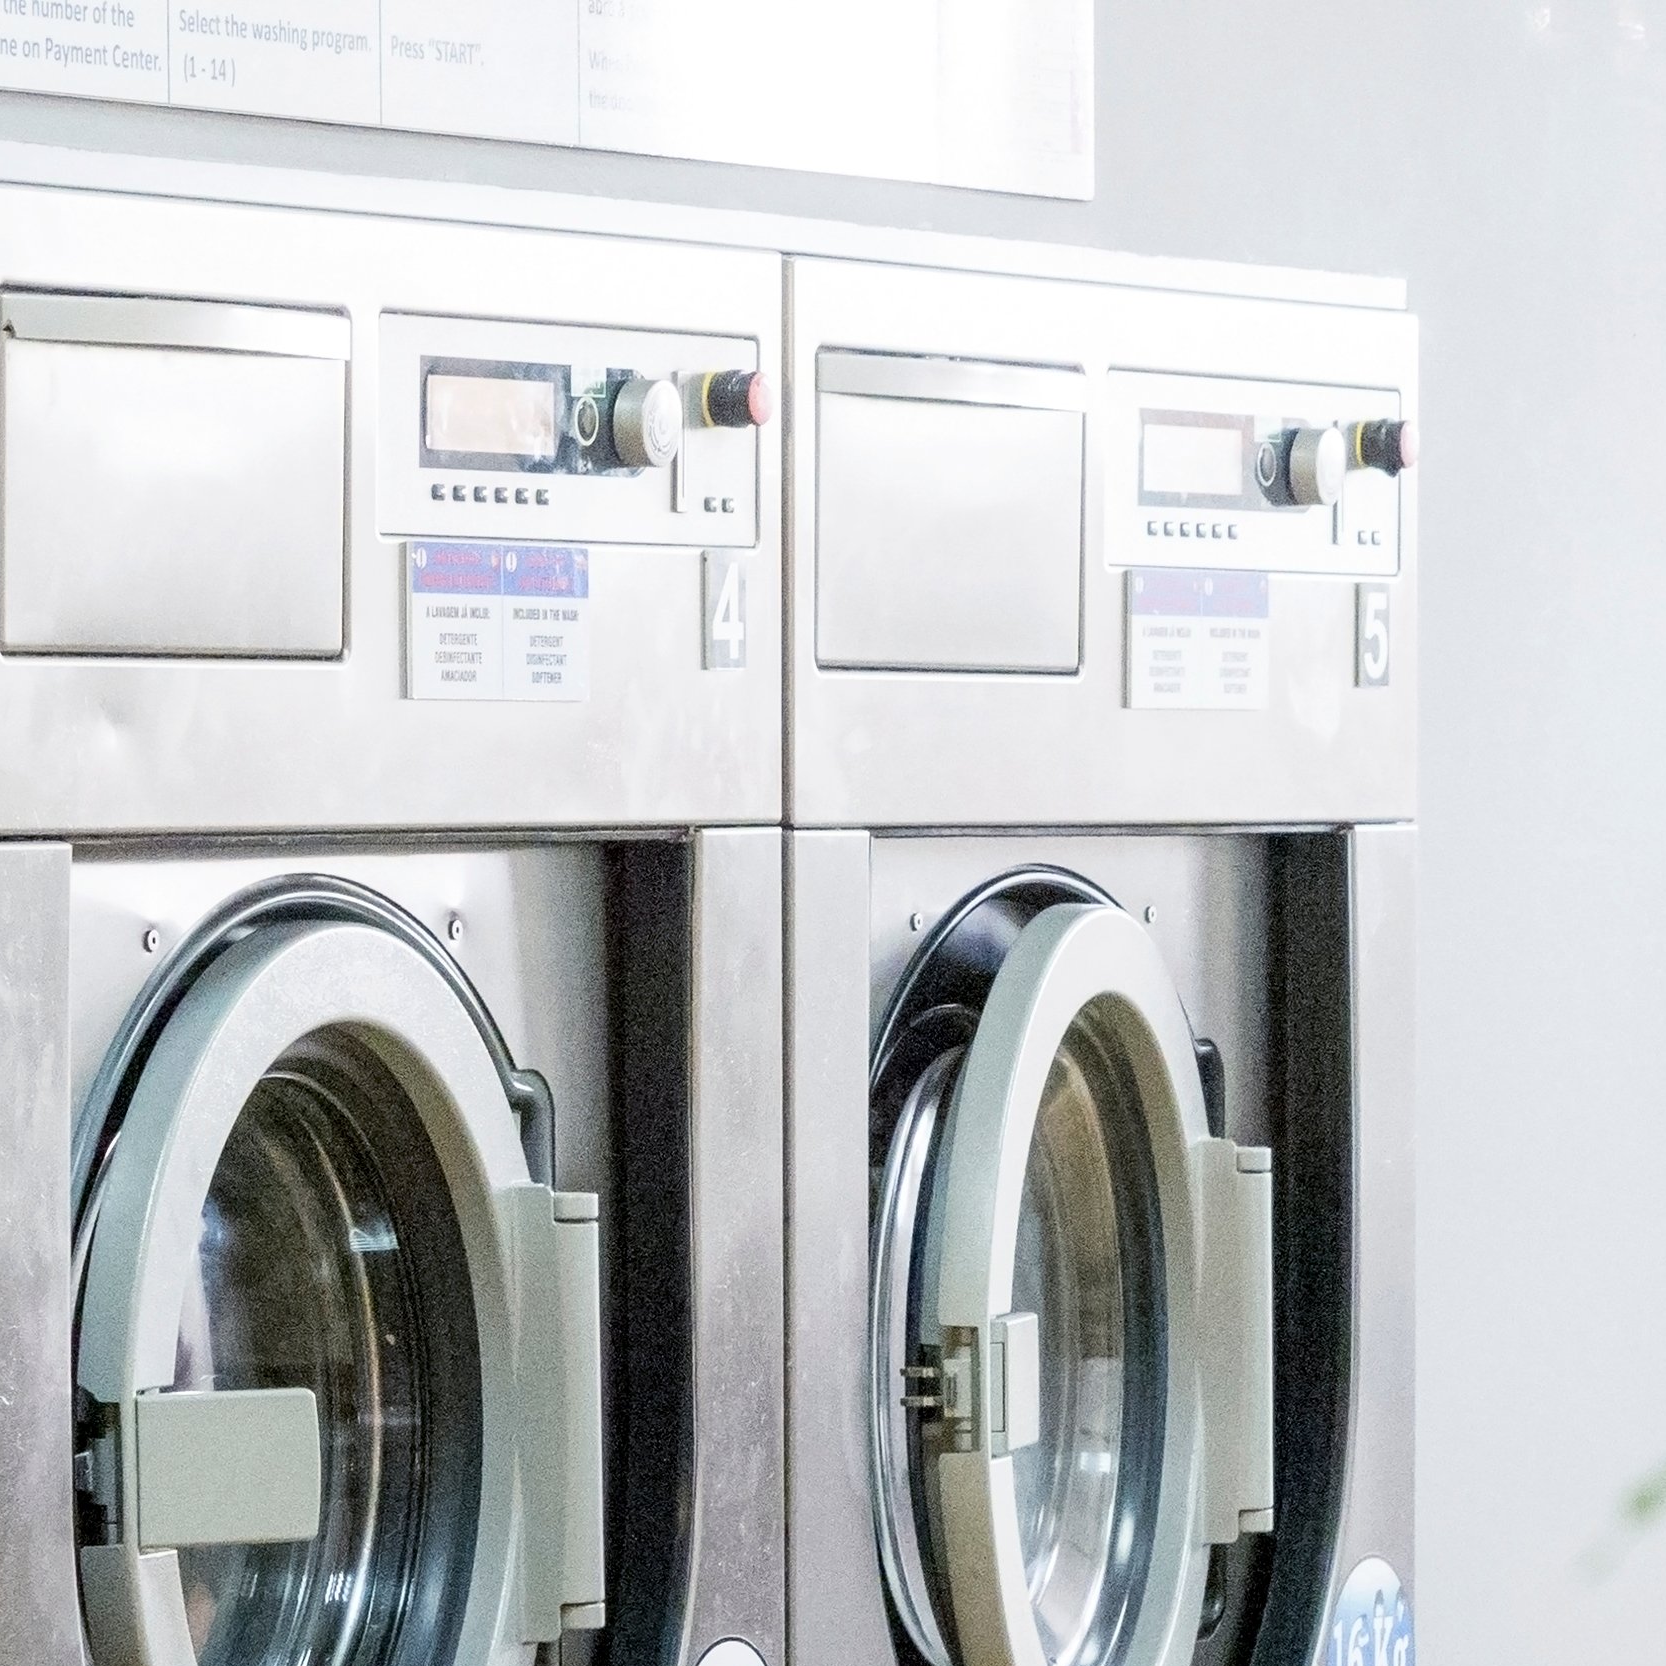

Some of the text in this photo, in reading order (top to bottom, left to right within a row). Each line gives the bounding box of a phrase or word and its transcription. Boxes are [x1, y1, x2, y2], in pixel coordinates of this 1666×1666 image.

[32, 0, 88, 22] number
[93, 2, 107, 24] of
[111, 3, 135, 27] the
[179, 9, 372, 55] Select the washing program.
[23, 42, 40, 59] on
[45, 38, 108, 67] Payment
[113, 44, 161, 71] Center.
[391, 35, 425, 60] Press
[712, 562, 745, 661] 4
[1364, 592, 1388, 679] 5
